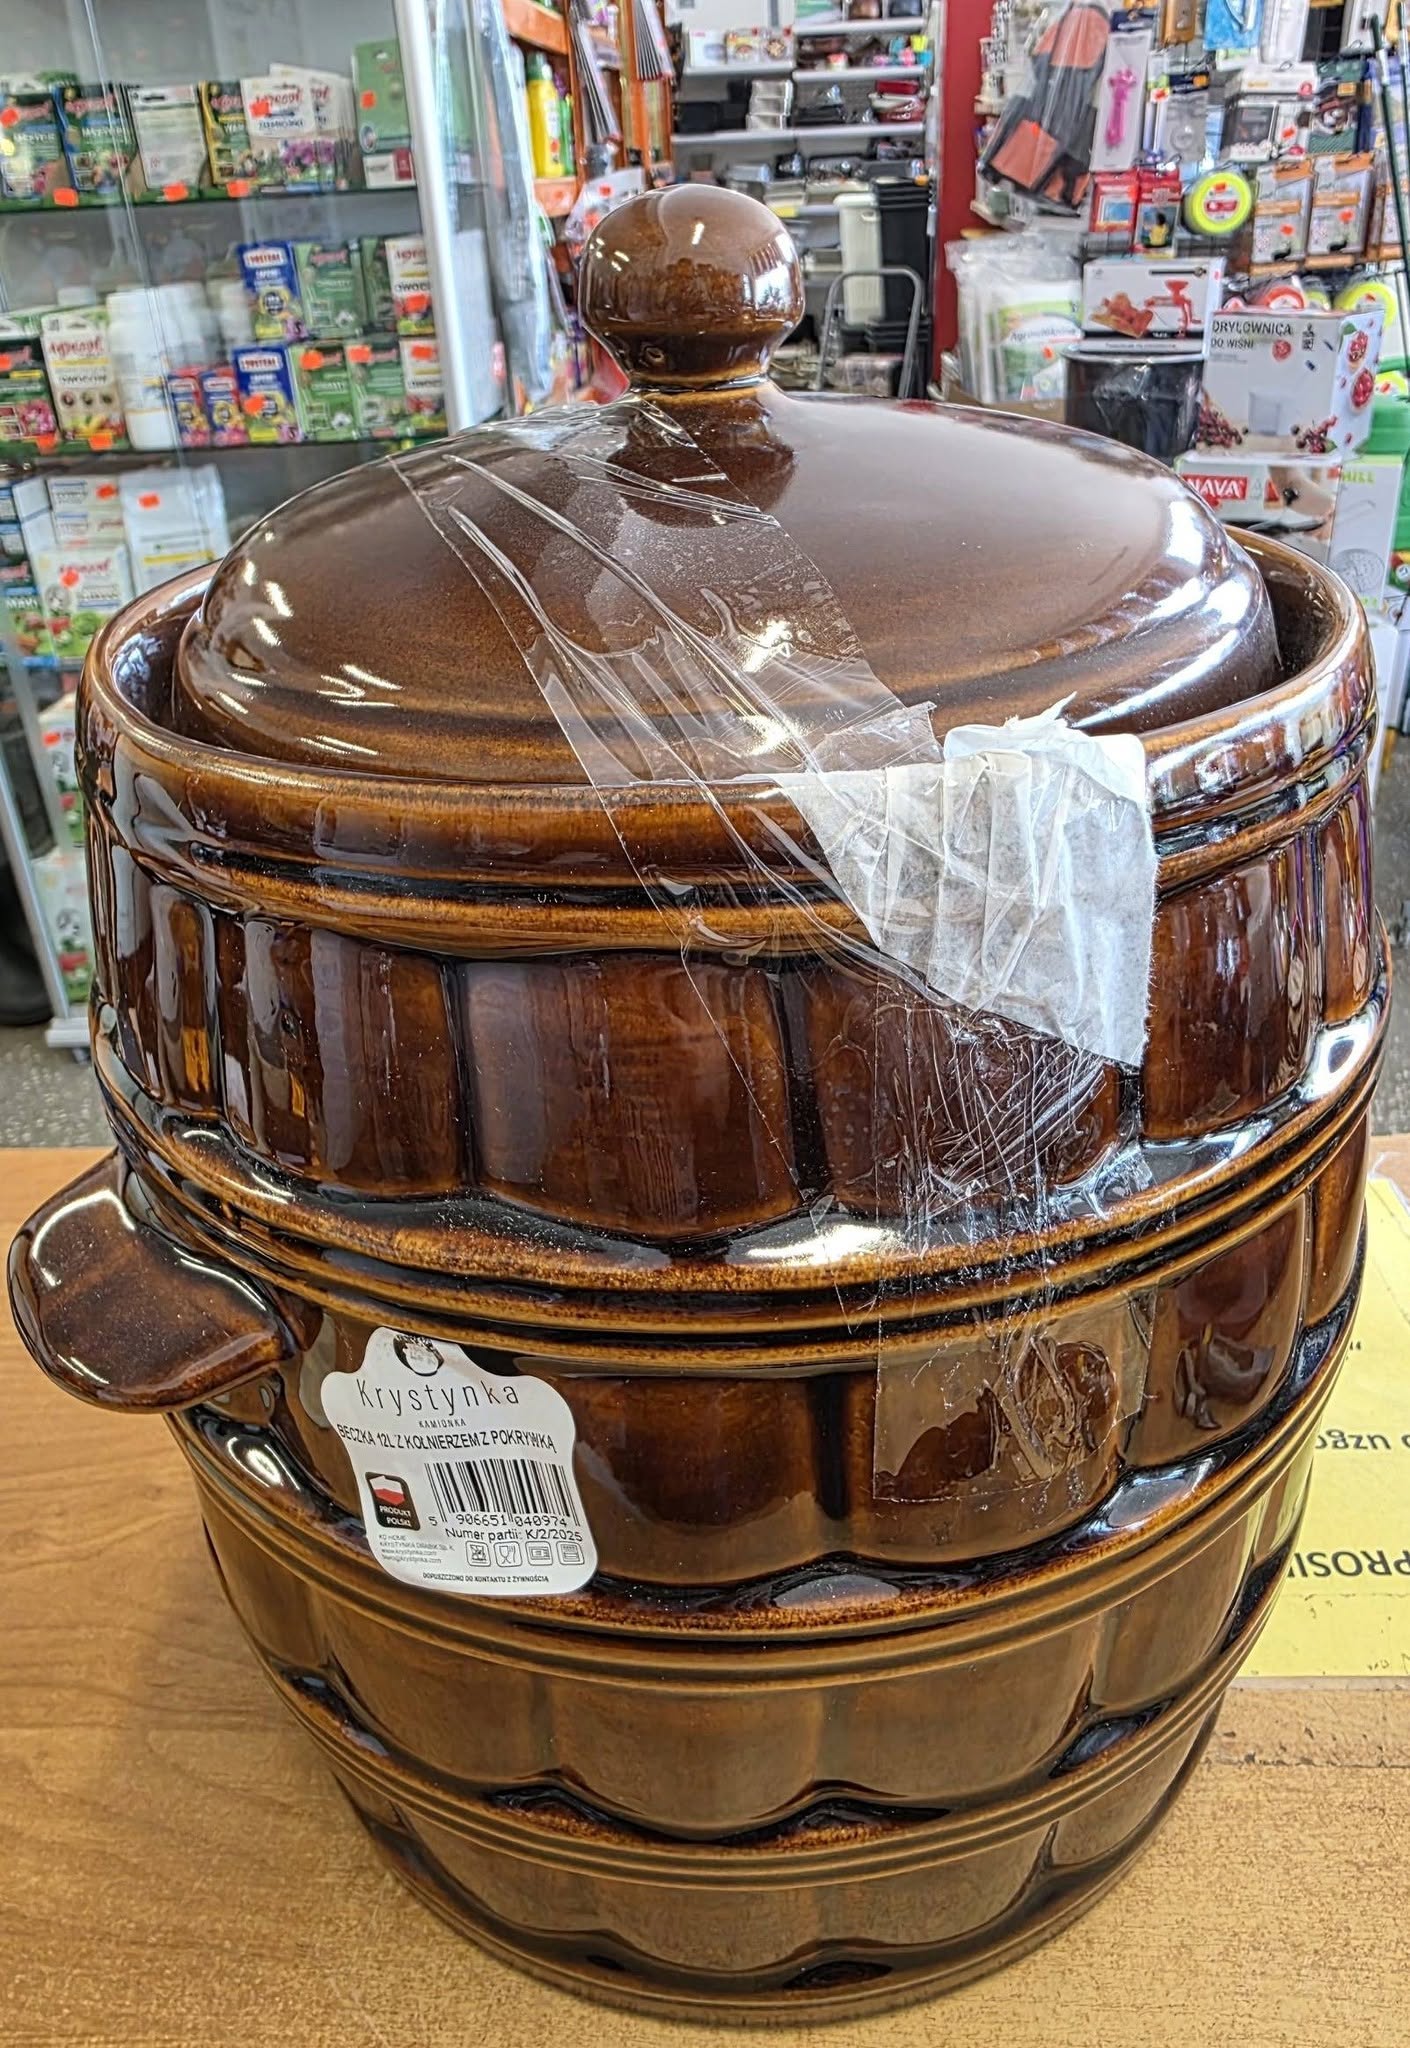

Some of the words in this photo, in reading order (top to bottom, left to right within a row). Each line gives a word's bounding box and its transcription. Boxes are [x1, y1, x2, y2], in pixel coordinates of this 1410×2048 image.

[356, 1379, 519, 1416] Krystynka
[419, 1418, 467, 1428] KAMIONKA
[337, 1423, 376, 1446] BECZKA
[492, 1429, 558, 1453] POKRYWKĄ
[379, 1505, 411, 1517] PRODUKT
[428, 1516, 438, 1526] 5
[455, 1513, 508, 1526] 906651
[514, 1515, 567, 1527] 040974
[445, 1528, 484, 1540] Numer
[488, 1528, 522, 1543] partii:
[525, 1529, 583, 1542] K/2/2025
[1288, 1550, 1410, 1578] PROSI
[423, 1572, 464, 1582] DOPUSZCZONO
[465, 1574, 473, 1582] DO
[474, 1575, 506, 1583] KONTAKTU
[512, 1573, 549, 1583] ŻYWNOŚCIĄ
